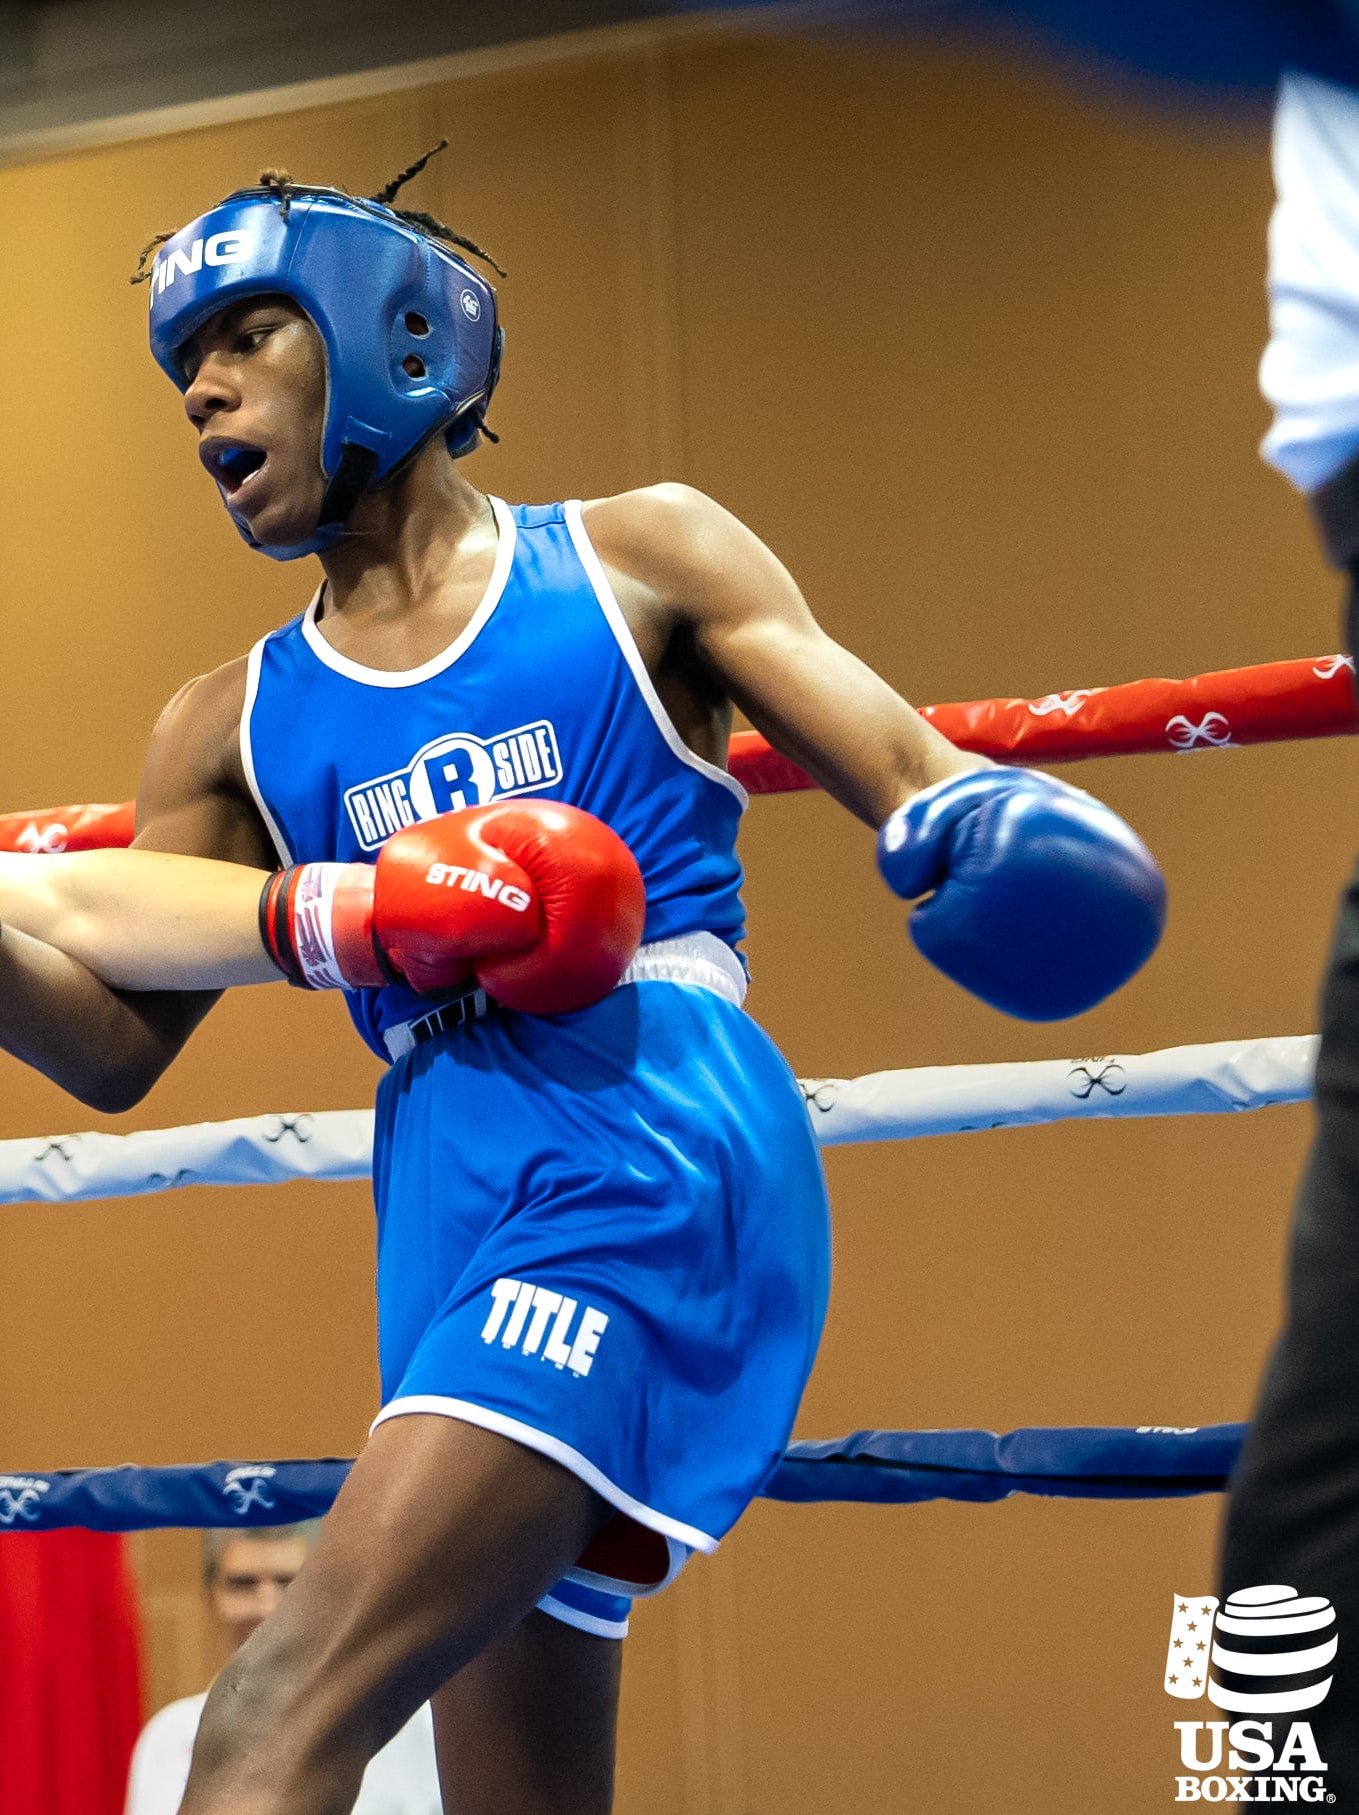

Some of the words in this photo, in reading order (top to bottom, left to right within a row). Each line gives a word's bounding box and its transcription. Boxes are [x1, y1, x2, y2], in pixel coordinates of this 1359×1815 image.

[150, 229, 255, 312] TING
[352, 778, 415, 843] RING
[424, 747, 479, 814] R
[493, 728, 555, 790] SIDE
[426, 862, 531, 912] STING
[481, 1277, 609, 1378] TITLE
